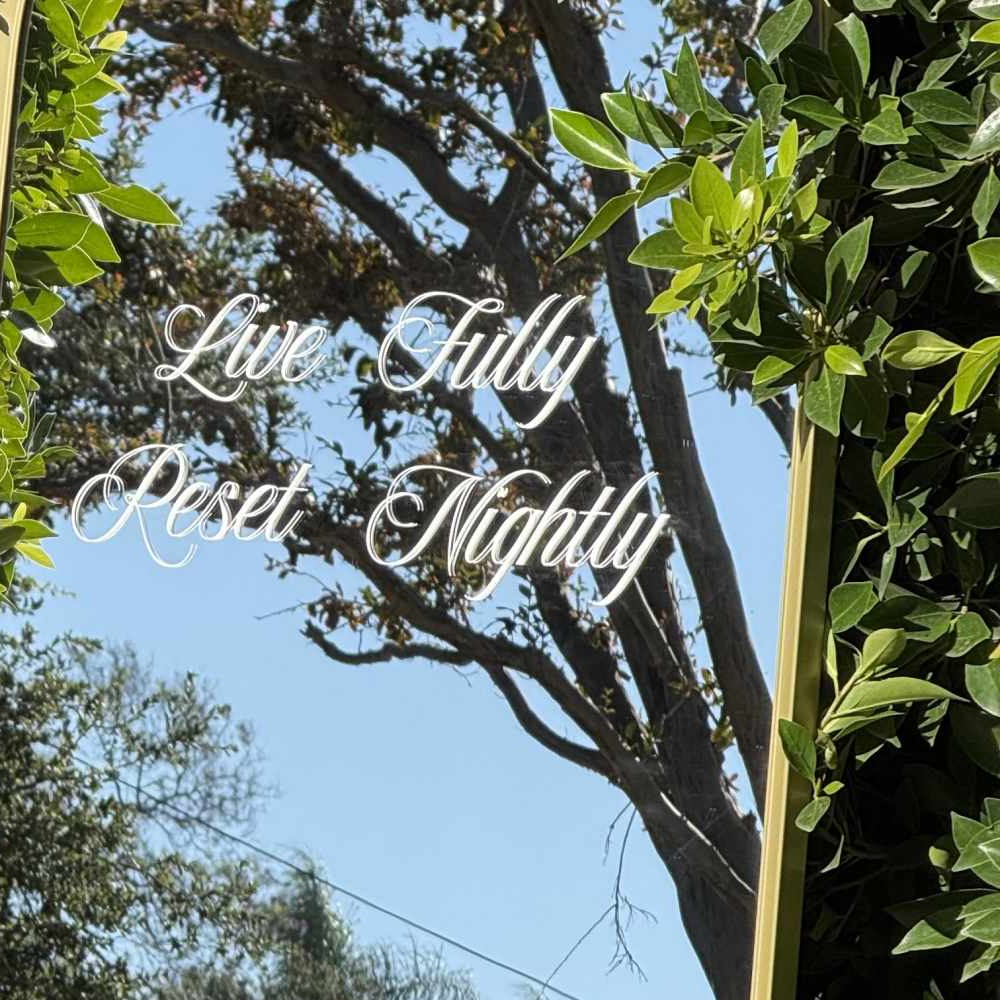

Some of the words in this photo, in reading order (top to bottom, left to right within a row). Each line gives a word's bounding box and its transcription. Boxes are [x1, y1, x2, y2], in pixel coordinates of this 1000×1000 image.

[154, 292, 328, 402] Live
[377, 291, 598, 429] Fully
[71, 443, 312, 568] Reset
[366, 464, 671, 606] Nightly
